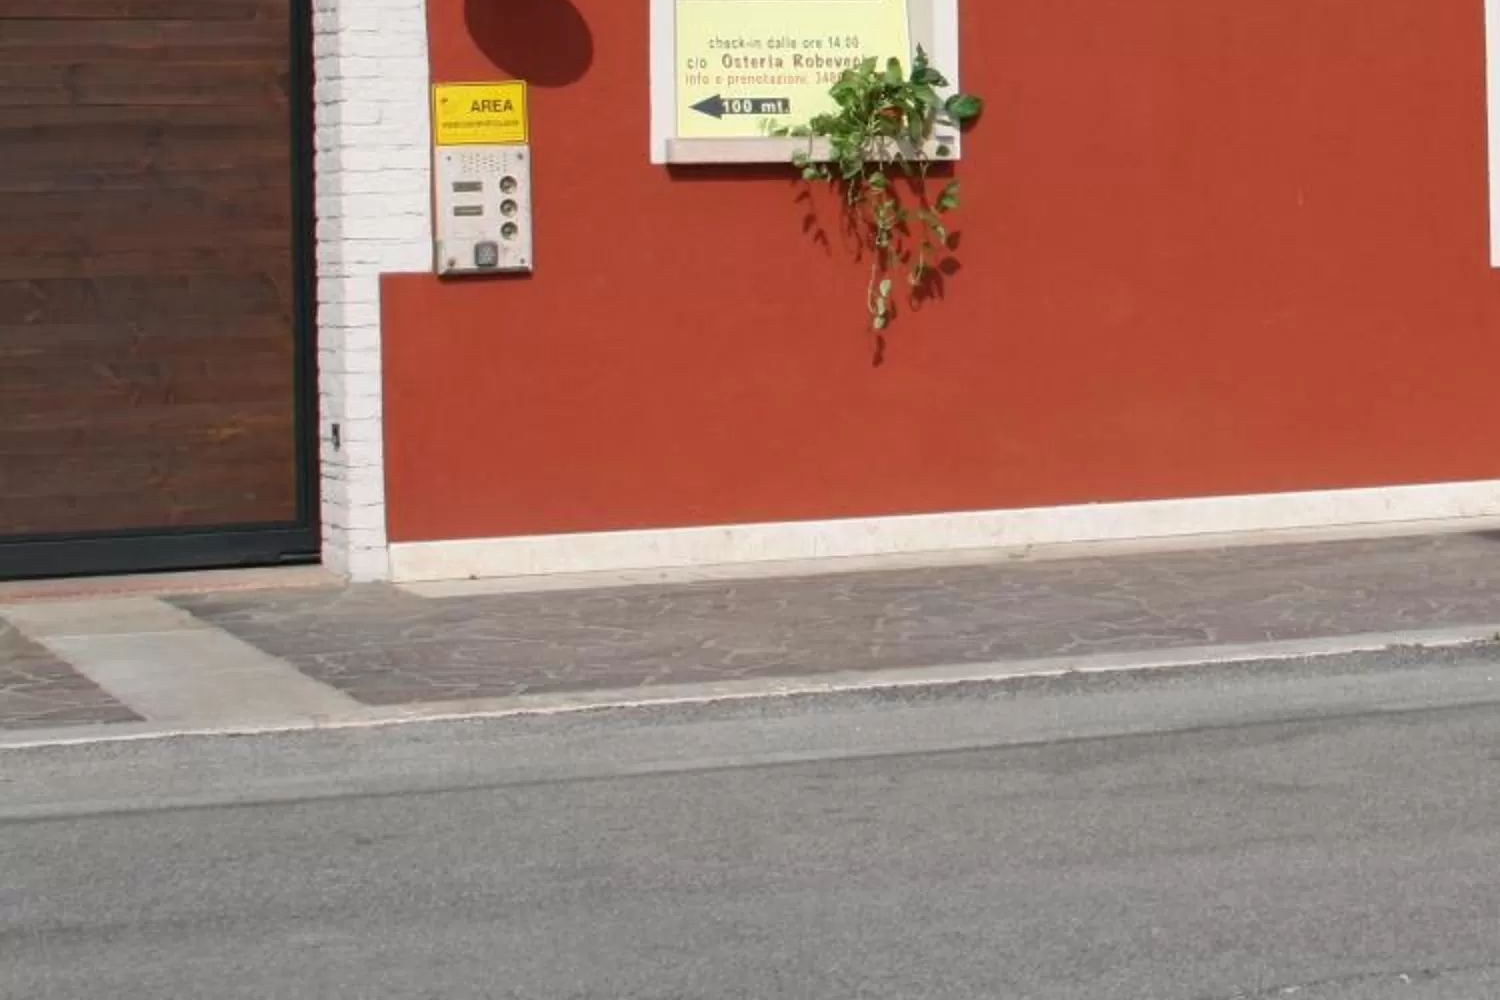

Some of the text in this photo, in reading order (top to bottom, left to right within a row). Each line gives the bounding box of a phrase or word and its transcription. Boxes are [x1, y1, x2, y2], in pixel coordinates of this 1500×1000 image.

[708, 36, 762, 49] check-in
[768, 36, 797, 49] dalle
[802, 38, 822, 49] ore
[721, 53, 784, 69] Osteria
[685, 72, 709, 86] info
[471, 99, 514, 112] AREA
[722, 99, 753, 113] 100
